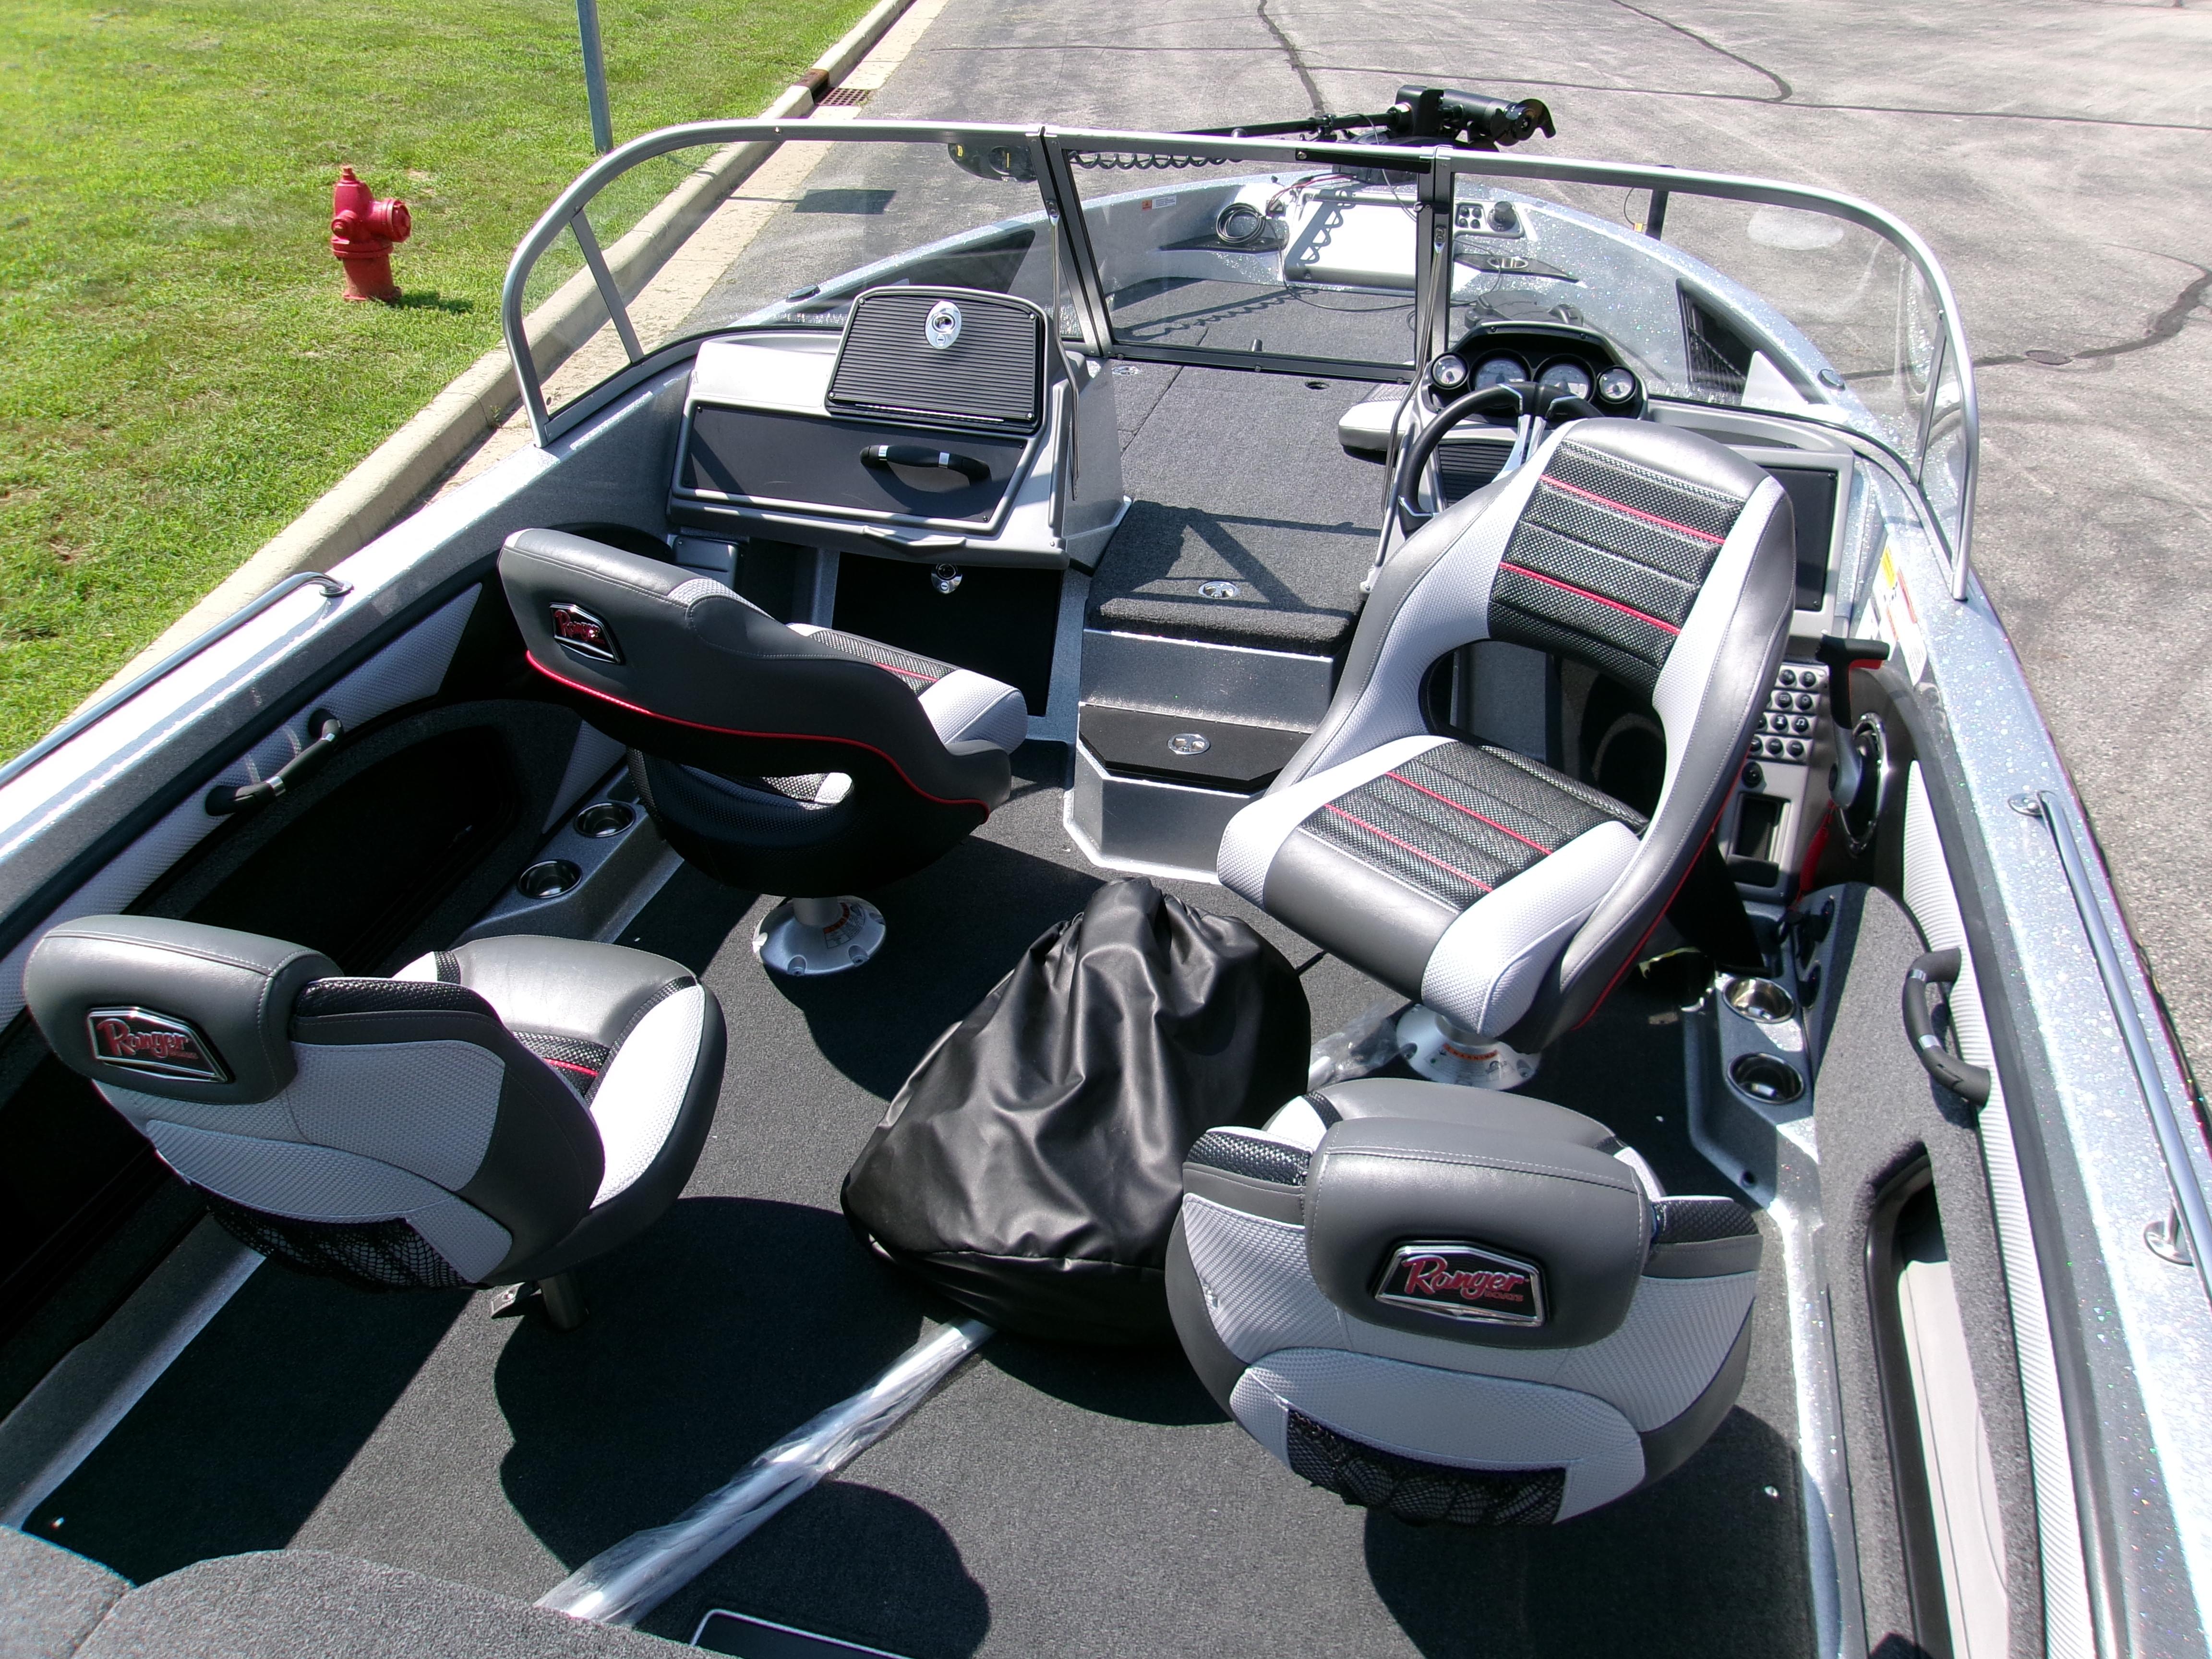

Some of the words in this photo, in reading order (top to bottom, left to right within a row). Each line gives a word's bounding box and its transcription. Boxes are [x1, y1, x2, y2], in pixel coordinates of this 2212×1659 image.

[553, 609, 601, 641] Ranger
[97, 1018, 189, 1058] Ranger
[1401, 1254, 1525, 1299] Ranger
